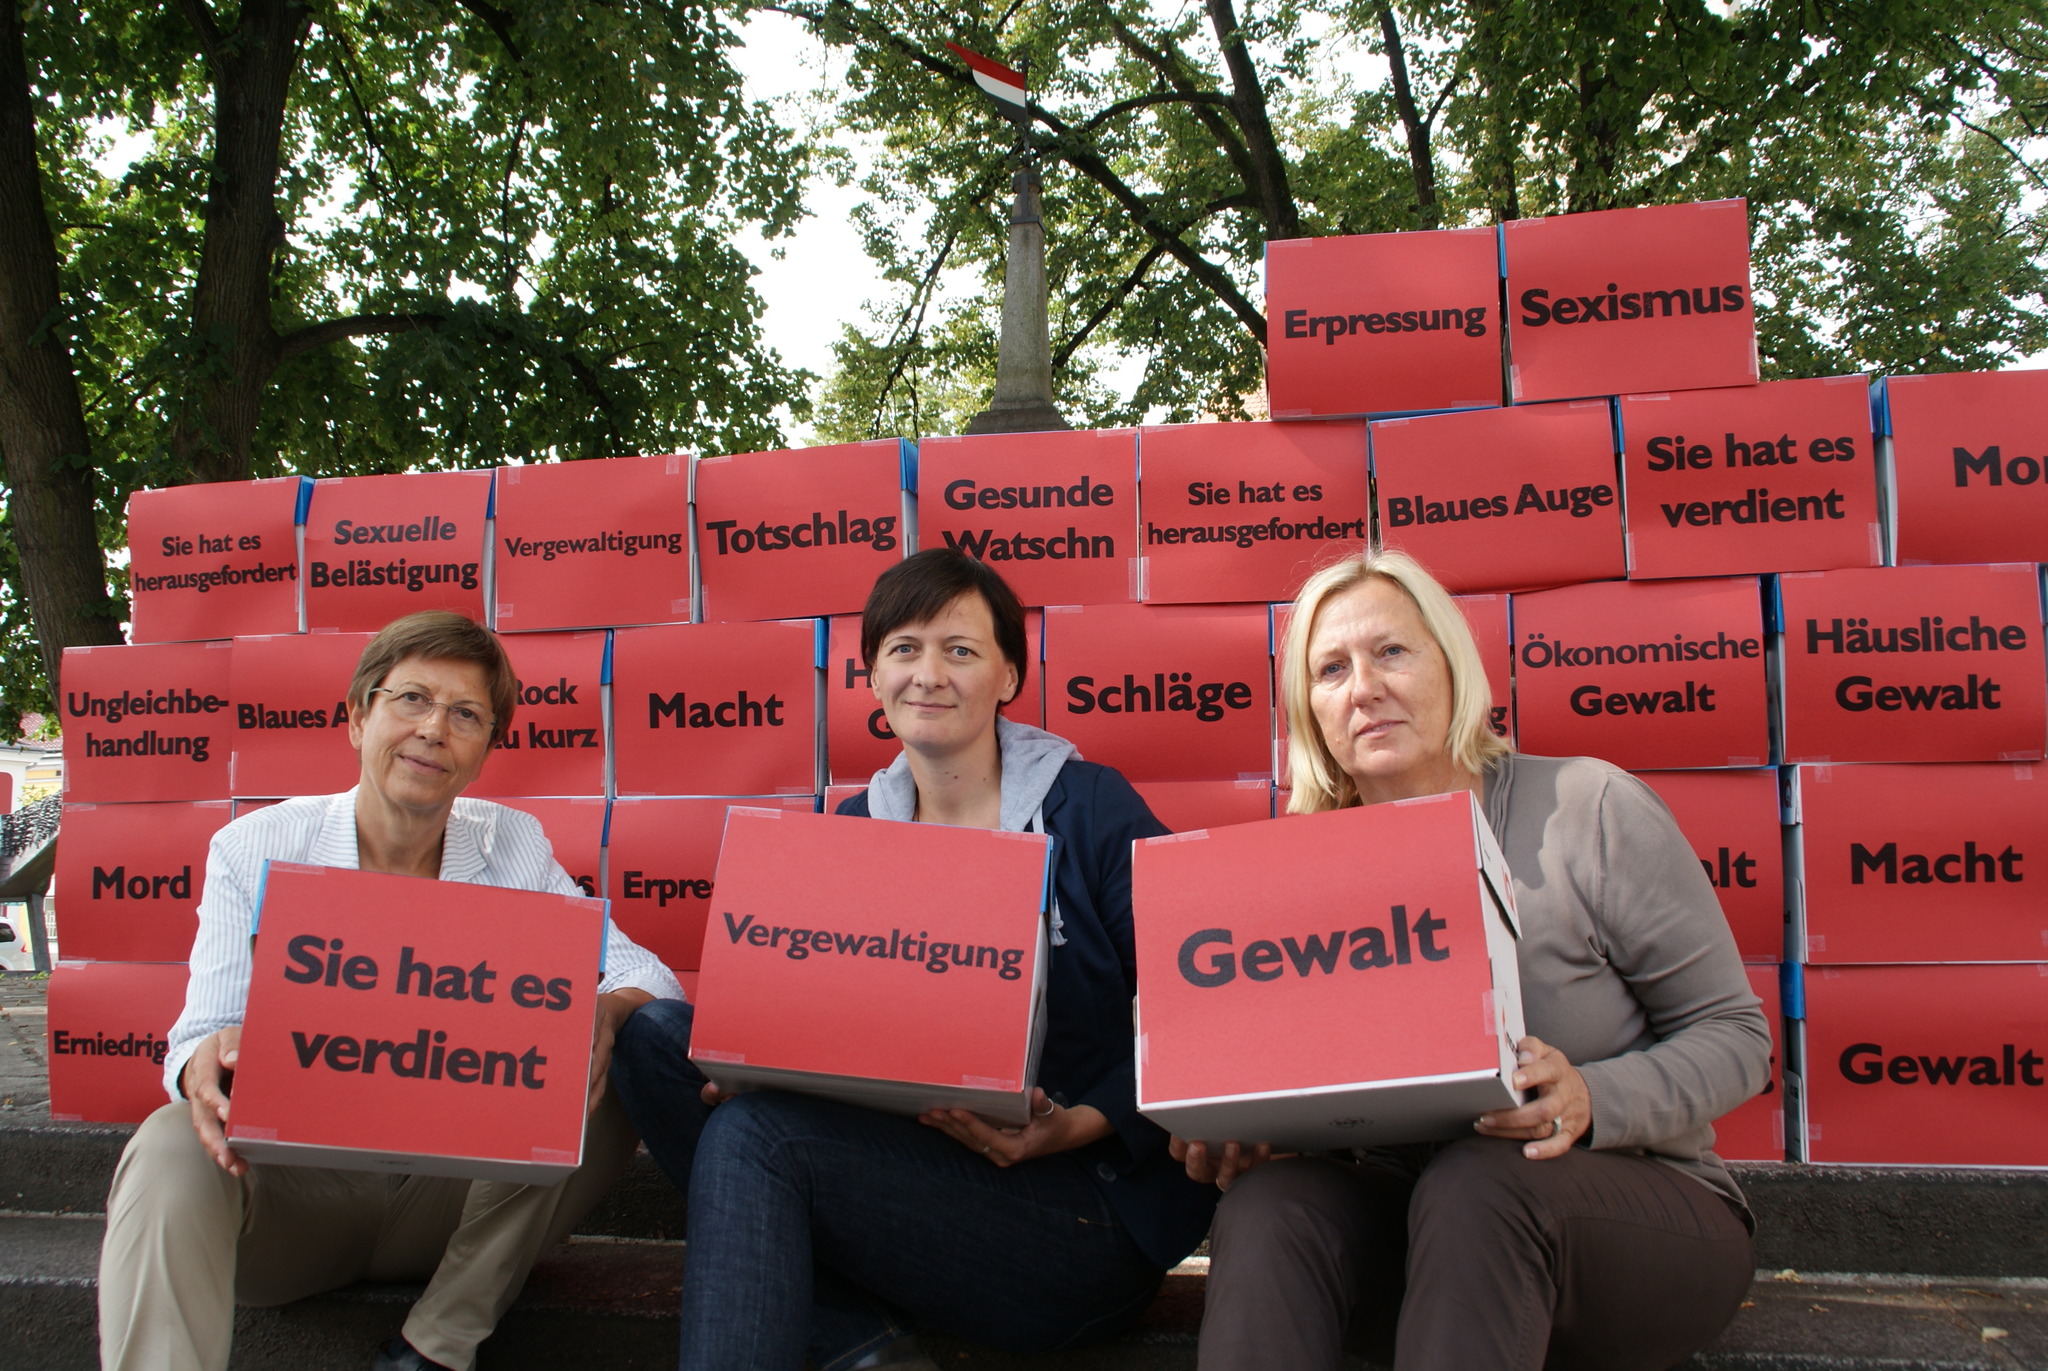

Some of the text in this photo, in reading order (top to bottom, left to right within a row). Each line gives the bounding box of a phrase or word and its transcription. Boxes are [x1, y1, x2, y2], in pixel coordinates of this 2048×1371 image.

[1520, 282, 1745, 327] Sexismus
[1285, 307, 1487, 346] Erpressung
[1646, 432, 1856, 472] Sie hat es
[1953, 445, 2048, 488] Mo
[943, 475, 1114, 511] Gesunde
[1187, 480, 1323, 506] Sie hat es
[1387, 483, 1614, 528] Blaues Auge
[1660, 487, 1845, 528] verdient
[161, 533, 262, 557] Sie hat es
[333, 515, 457, 546] Sexuelle
[504, 530, 682, 561] Vergewaltigung
[705, 509, 897, 556] Totschlag
[941, 527, 1115, 562] Watschn
[1147, 515, 1365, 549] herausgefordert
[134, 562, 297, 593] herausgefordert
[310, 558, 479, 592] Belästigung
[1521, 630, 1761, 669] Ökonomische
[1806, 615, 2027, 655] Häusliche
[67, 688, 229, 724] Ungleichbe-
[648, 690, 784, 729] Macht
[1066, 672, 1252, 723] Schläge
[1570, 680, 1716, 717] Gewalt
[1835, 673, 2001, 712] Gewalt
[237, 703, 327, 730] Blaues
[528, 722, 599, 749] kurz
[86, 730, 210, 763] handlung
[92, 865, 191, 900] Mord
[1850, 841, 2024, 885] Macht
[623, 870, 714, 908] Erpre
[723, 912, 1025, 981] Vergewaltigung
[1177, 904, 1450, 988] Gewalt
[283, 934, 572, 1012] Sie hat es
[291, 1029, 547, 1090] verdient
[1838, 1042, 2045, 1087] Gewalt
